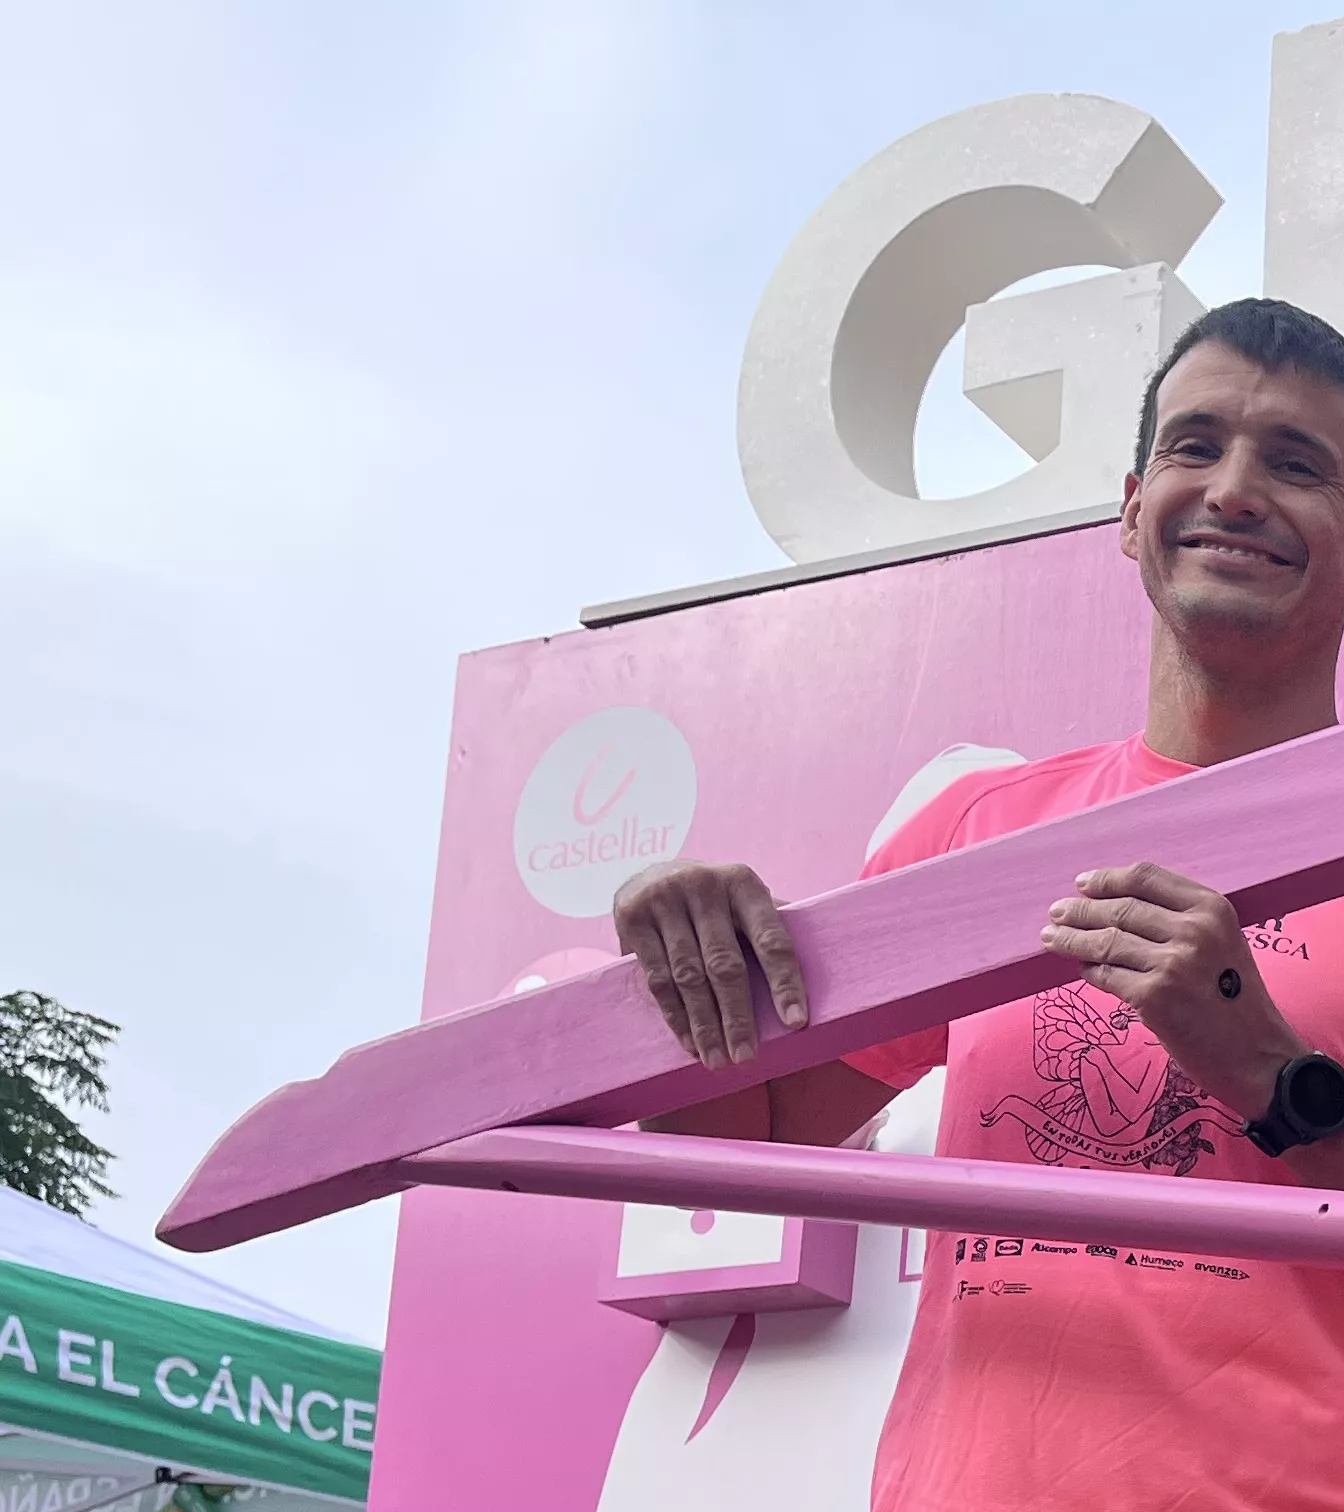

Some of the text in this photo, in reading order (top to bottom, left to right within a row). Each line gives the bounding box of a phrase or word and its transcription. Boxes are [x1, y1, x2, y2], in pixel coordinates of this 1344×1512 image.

[528, 815, 675, 872] castellar
[1058, 1132, 1091, 1151] TODAS
[57, 1328, 141, 1398] EL
